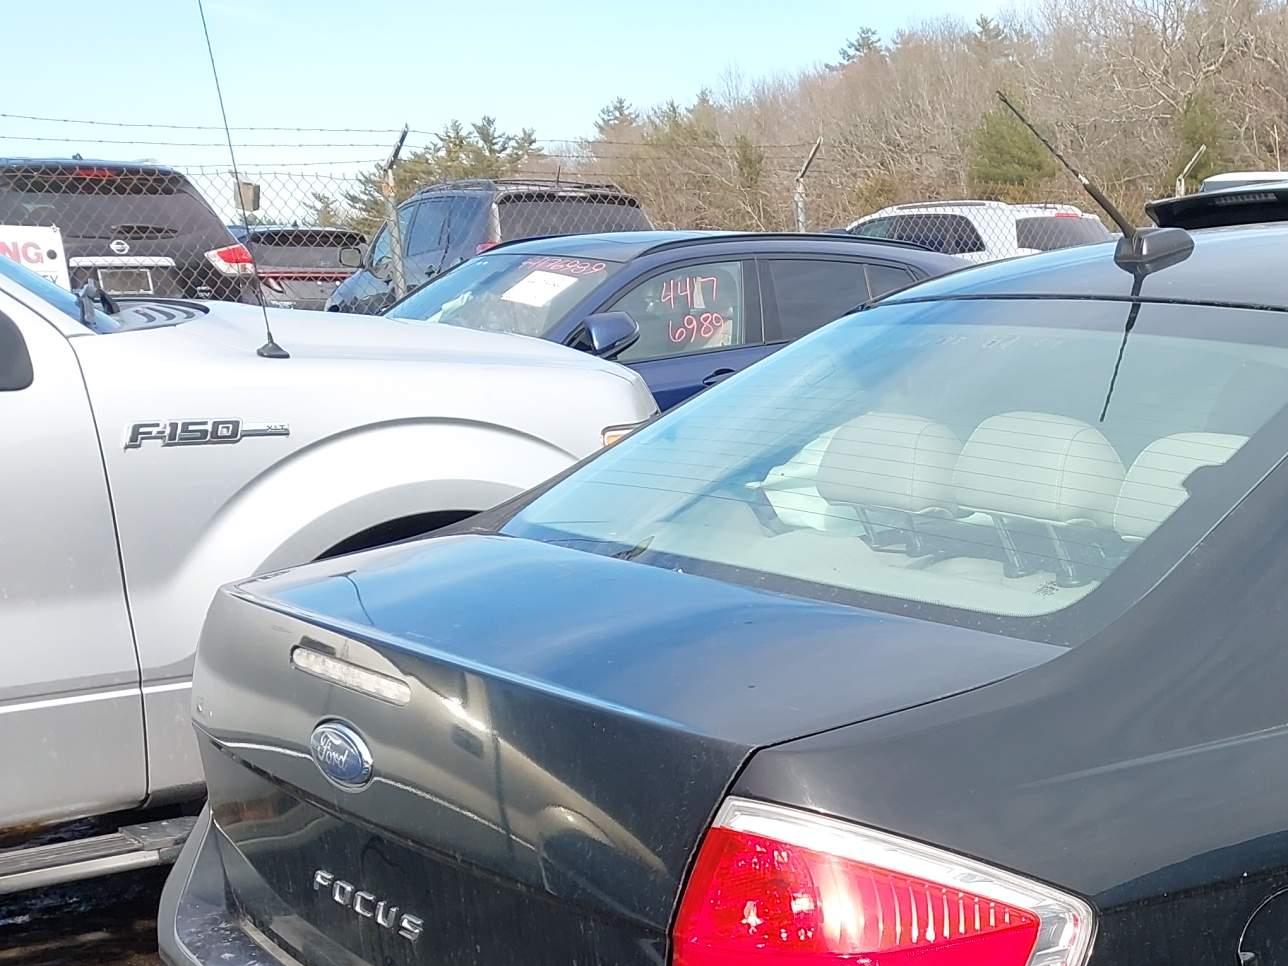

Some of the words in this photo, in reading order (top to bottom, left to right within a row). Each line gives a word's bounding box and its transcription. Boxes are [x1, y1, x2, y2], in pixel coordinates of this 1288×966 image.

[669, 312, 725, 343] 6989
[125, 419, 241, 451] F-150
[313, 869, 425, 943] FOCUS
